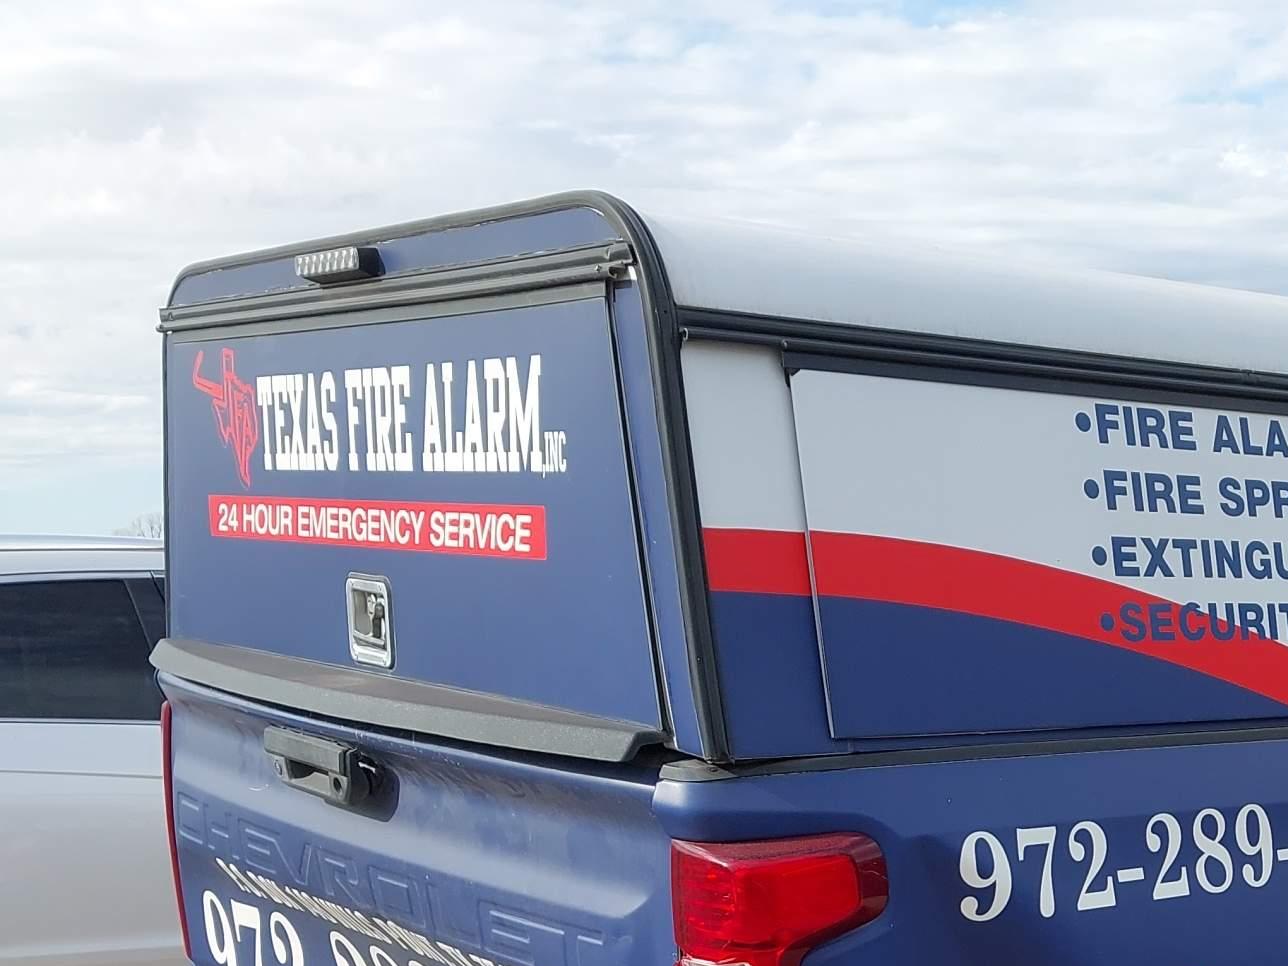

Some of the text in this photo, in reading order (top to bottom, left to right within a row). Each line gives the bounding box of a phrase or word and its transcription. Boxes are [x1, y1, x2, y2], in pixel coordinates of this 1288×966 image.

[256, 370, 340, 471] TEXAS
[344, 365, 414, 472] FIRE
[1094, 403, 1198, 451] FIRE
[1102, 469, 1205, 516] FIRE
[217, 504, 532, 553] 24 HOUR EMERGENCY SERVICE
